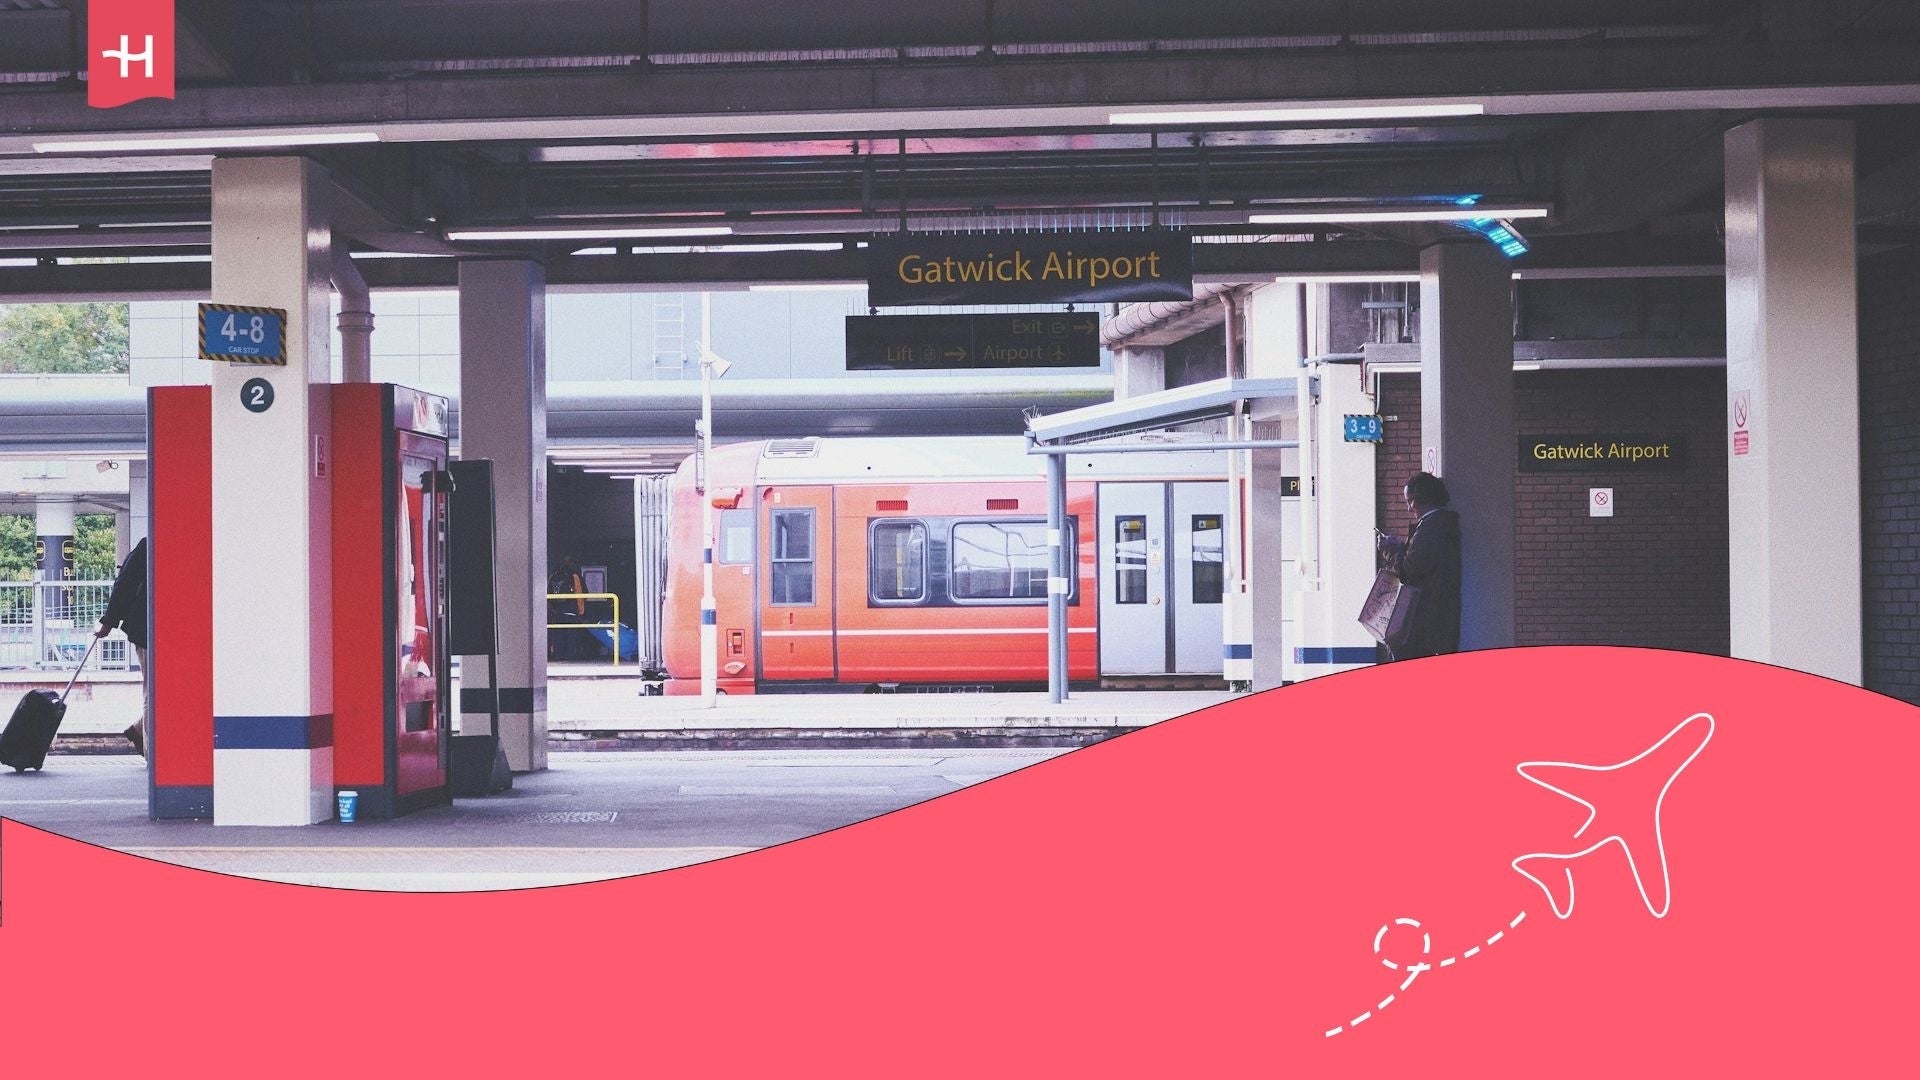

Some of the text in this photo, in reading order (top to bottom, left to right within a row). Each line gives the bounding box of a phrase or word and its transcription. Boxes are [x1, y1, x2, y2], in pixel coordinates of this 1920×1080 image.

[899, 250, 1161, 287] Gatwick Airport
[220, 313, 265, 344] 4-8
[1012, 319, 1042, 335] Exit
[887, 345, 913, 362] Lift
[983, 344, 1043, 363] Airport
[250, 385, 265, 405] 2
[1533, 442, 1670, 462] Gatwick Airport
